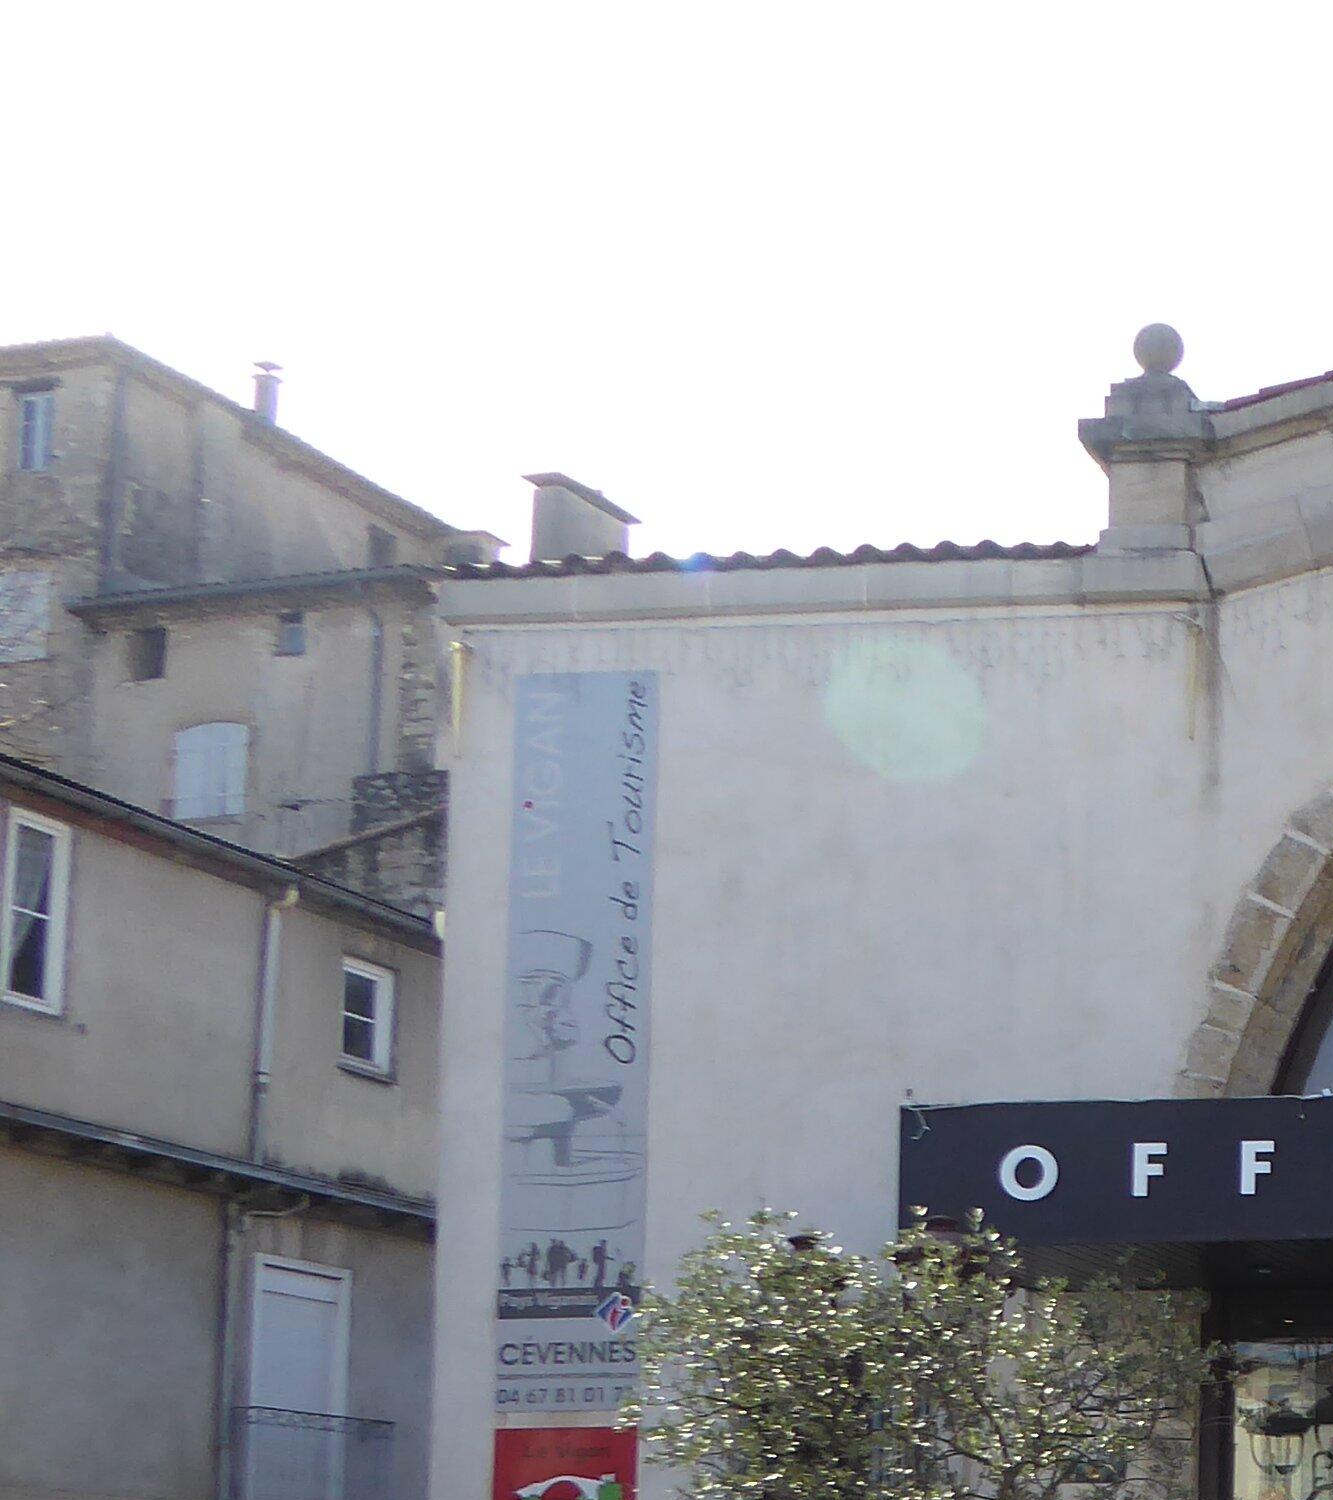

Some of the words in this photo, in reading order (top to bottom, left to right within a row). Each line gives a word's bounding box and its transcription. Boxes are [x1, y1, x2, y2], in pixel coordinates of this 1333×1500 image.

[605, 680, 649, 863] Tourisme
[608, 880, 640, 921] de
[498, 1336, 637, 1366] CÉVENNES
[497, 1387, 521, 1405] 04
[526, 1387, 548, 1404] 67
